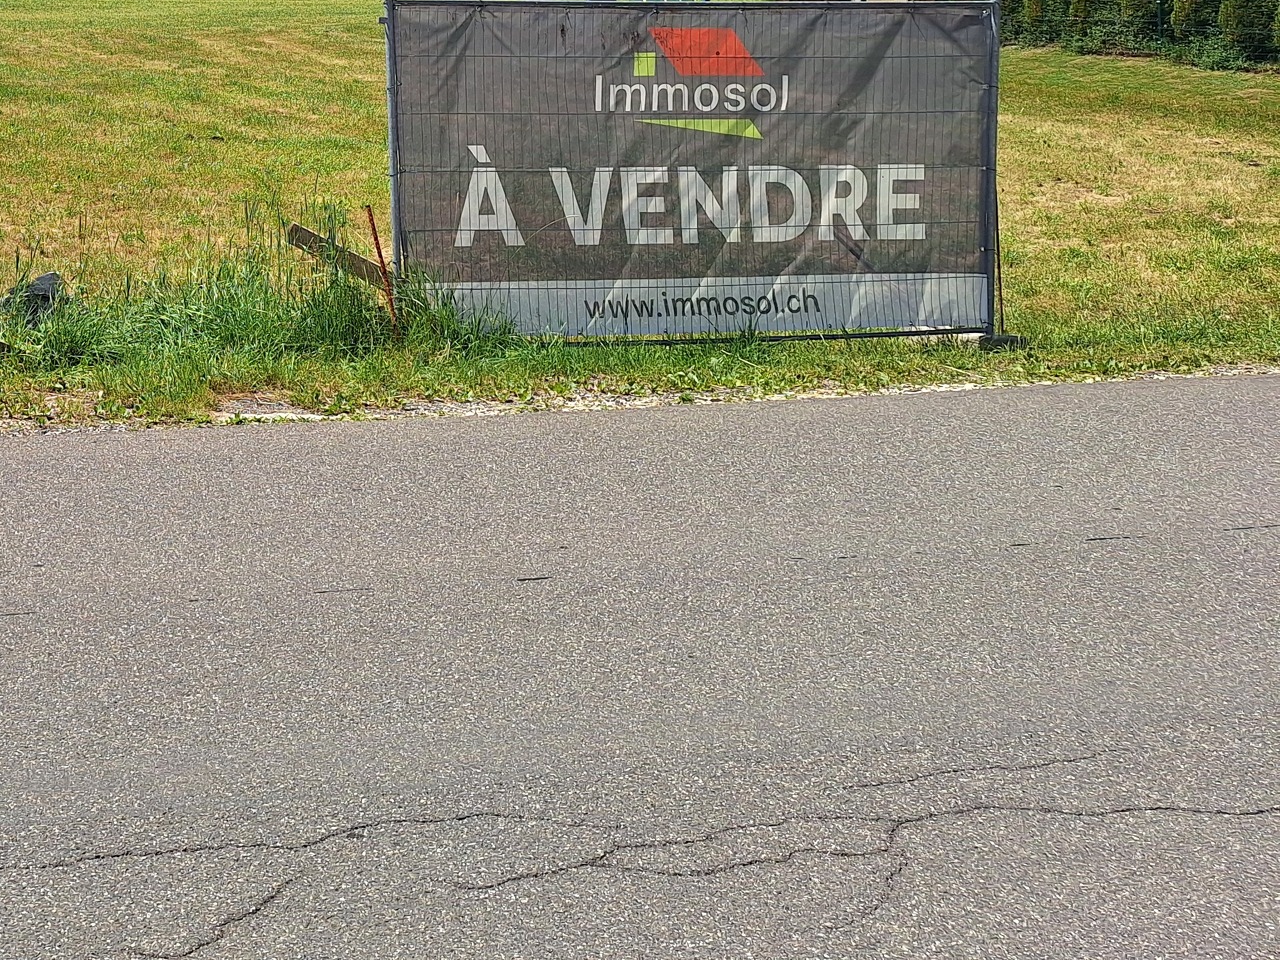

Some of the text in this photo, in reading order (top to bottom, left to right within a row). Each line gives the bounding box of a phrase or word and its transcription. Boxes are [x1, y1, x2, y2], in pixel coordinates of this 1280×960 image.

[594, 73, 790, 113] Immosol
[453, 143, 927, 248] À VENDRE
[583, 286, 821, 319] www.immosol.ch
